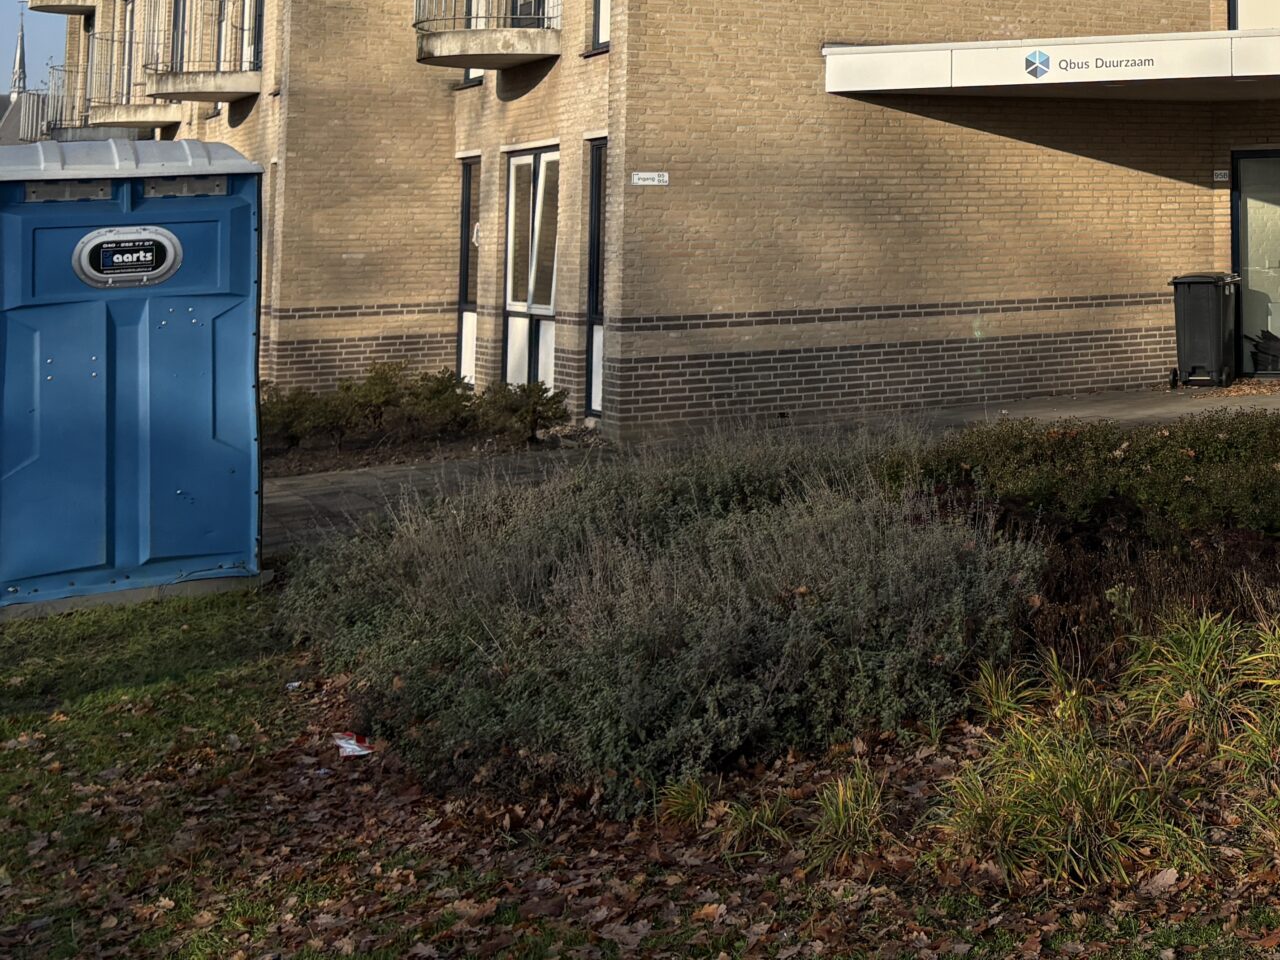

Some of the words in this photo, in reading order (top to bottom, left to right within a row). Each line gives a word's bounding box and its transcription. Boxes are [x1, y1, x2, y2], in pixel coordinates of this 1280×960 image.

[1058, 58, 1090, 72] Qbus
[1095, 58, 1155, 69] Duurzaam
[113, 251, 152, 262] aarts
